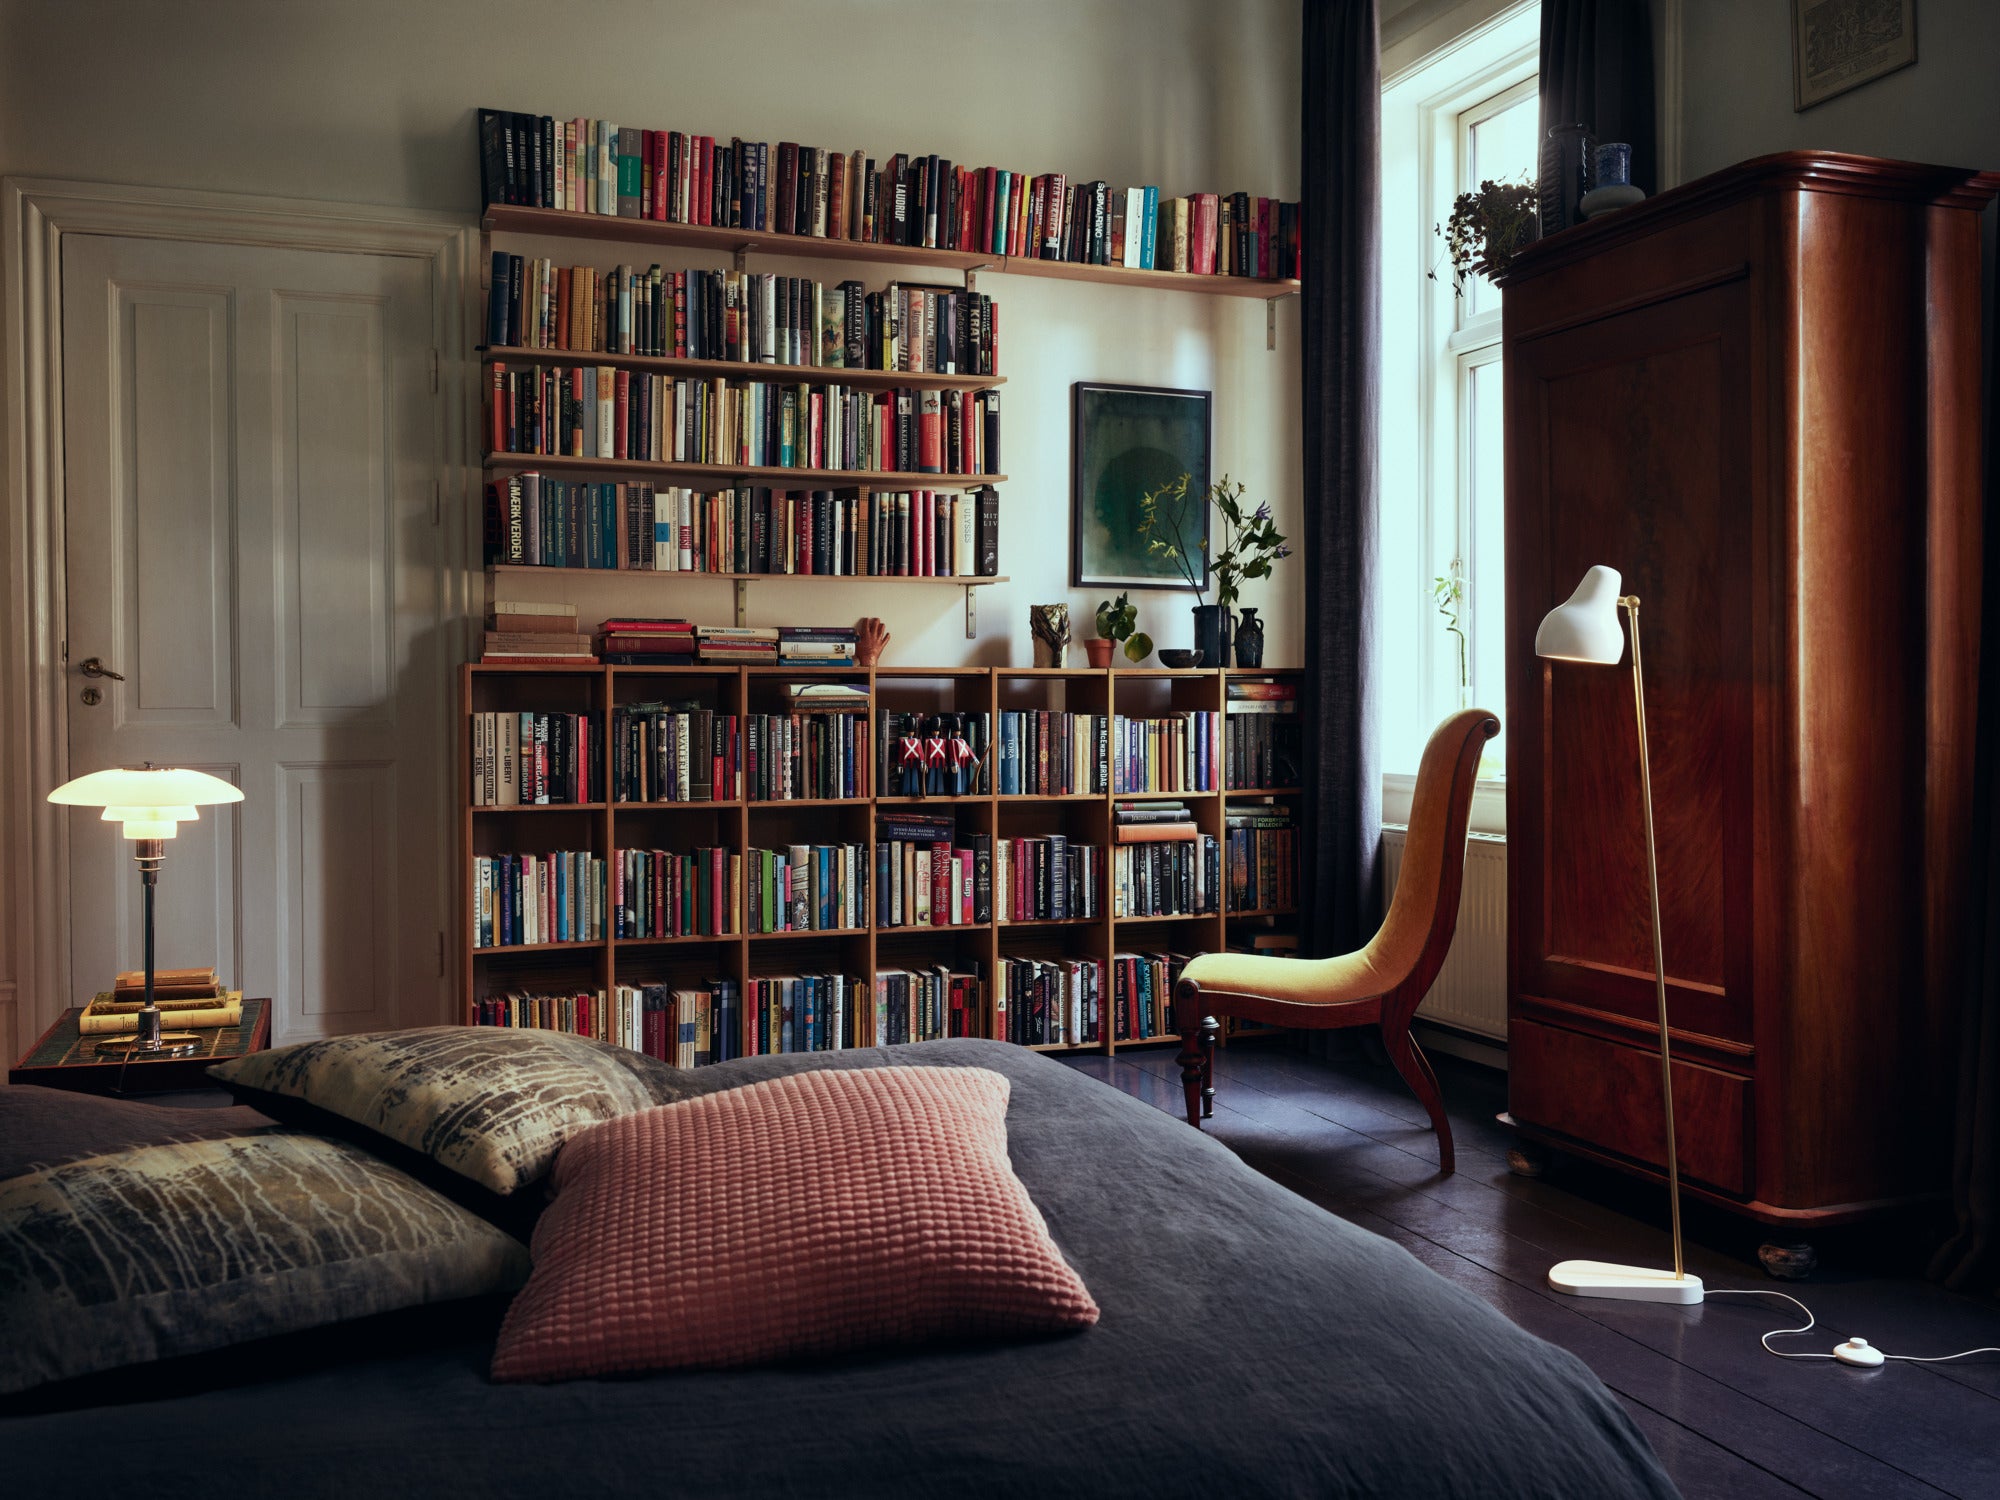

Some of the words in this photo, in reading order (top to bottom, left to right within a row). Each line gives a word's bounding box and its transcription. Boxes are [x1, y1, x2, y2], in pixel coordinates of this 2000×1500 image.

[895, 183, 906, 222] LAUDRUP
[1095, 182, 1105, 238] SUBMARINO
[970, 309, 980, 344] KRAT
[510, 486, 522, 517] MÆRK
[754, 513, 760, 521] OG
[510, 518, 522, 559] VERDEN
[678, 735, 686, 779] VALERIA
[1007, 738, 1015, 759] TORA
[486, 756, 494, 799] REVOLUTION
[504, 755, 512, 784] LIBERTY
[932, 846, 941, 881] IRVING
[941, 850, 951, 876] JOHN
